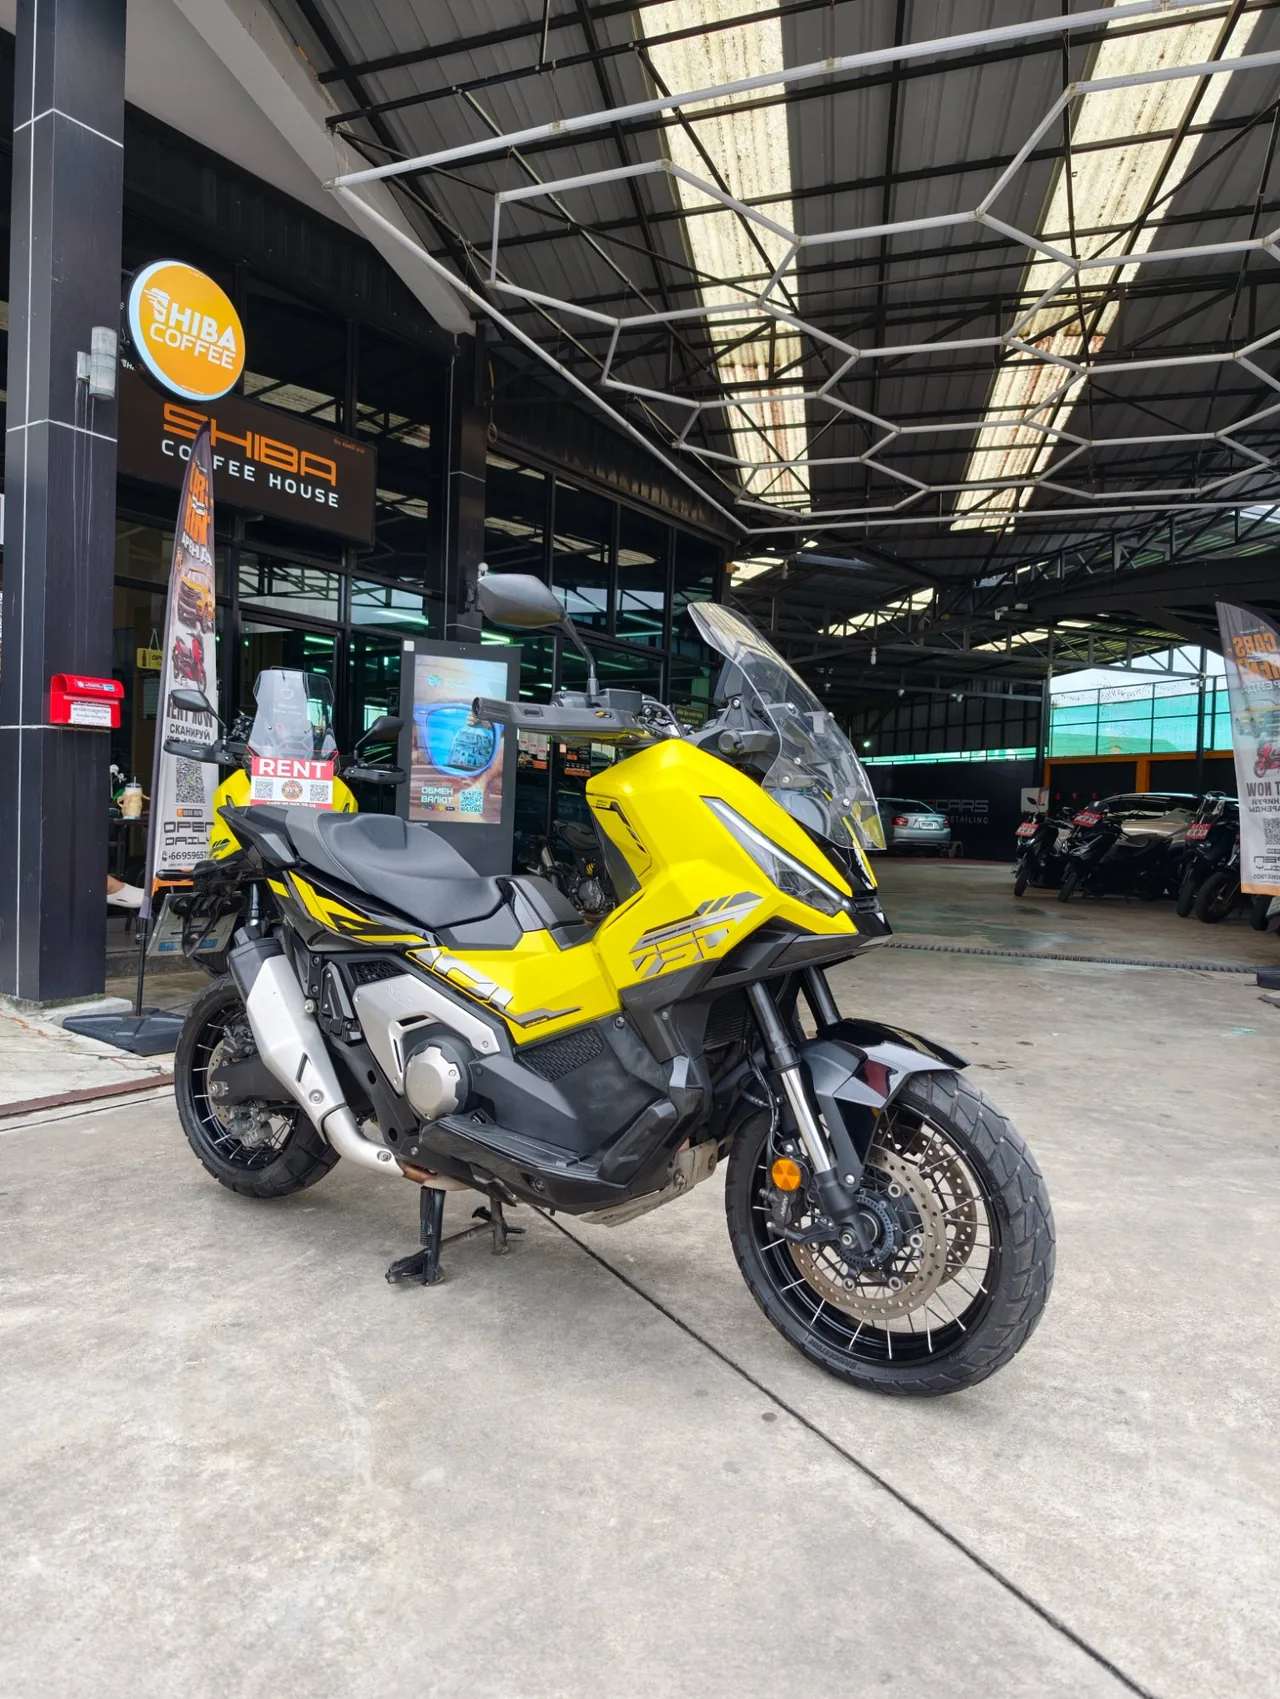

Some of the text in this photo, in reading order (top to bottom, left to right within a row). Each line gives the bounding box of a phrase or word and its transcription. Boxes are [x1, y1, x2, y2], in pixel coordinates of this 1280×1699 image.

[144, 287, 236, 352] SHIBA
[150, 322, 236, 370] COFFEE
[163, 402, 337, 487] SHIBA
[161, 439, 340, 508] COFEE HOUSE
[170, 723, 211, 741] СКАНИРУЙ
[258, 757, 327, 779] RENT
[420, 795, 454, 805] ВАЛЮТ
[421, 786, 454, 795] ОБМЕН
[950, 815, 989, 824] ETAILING
